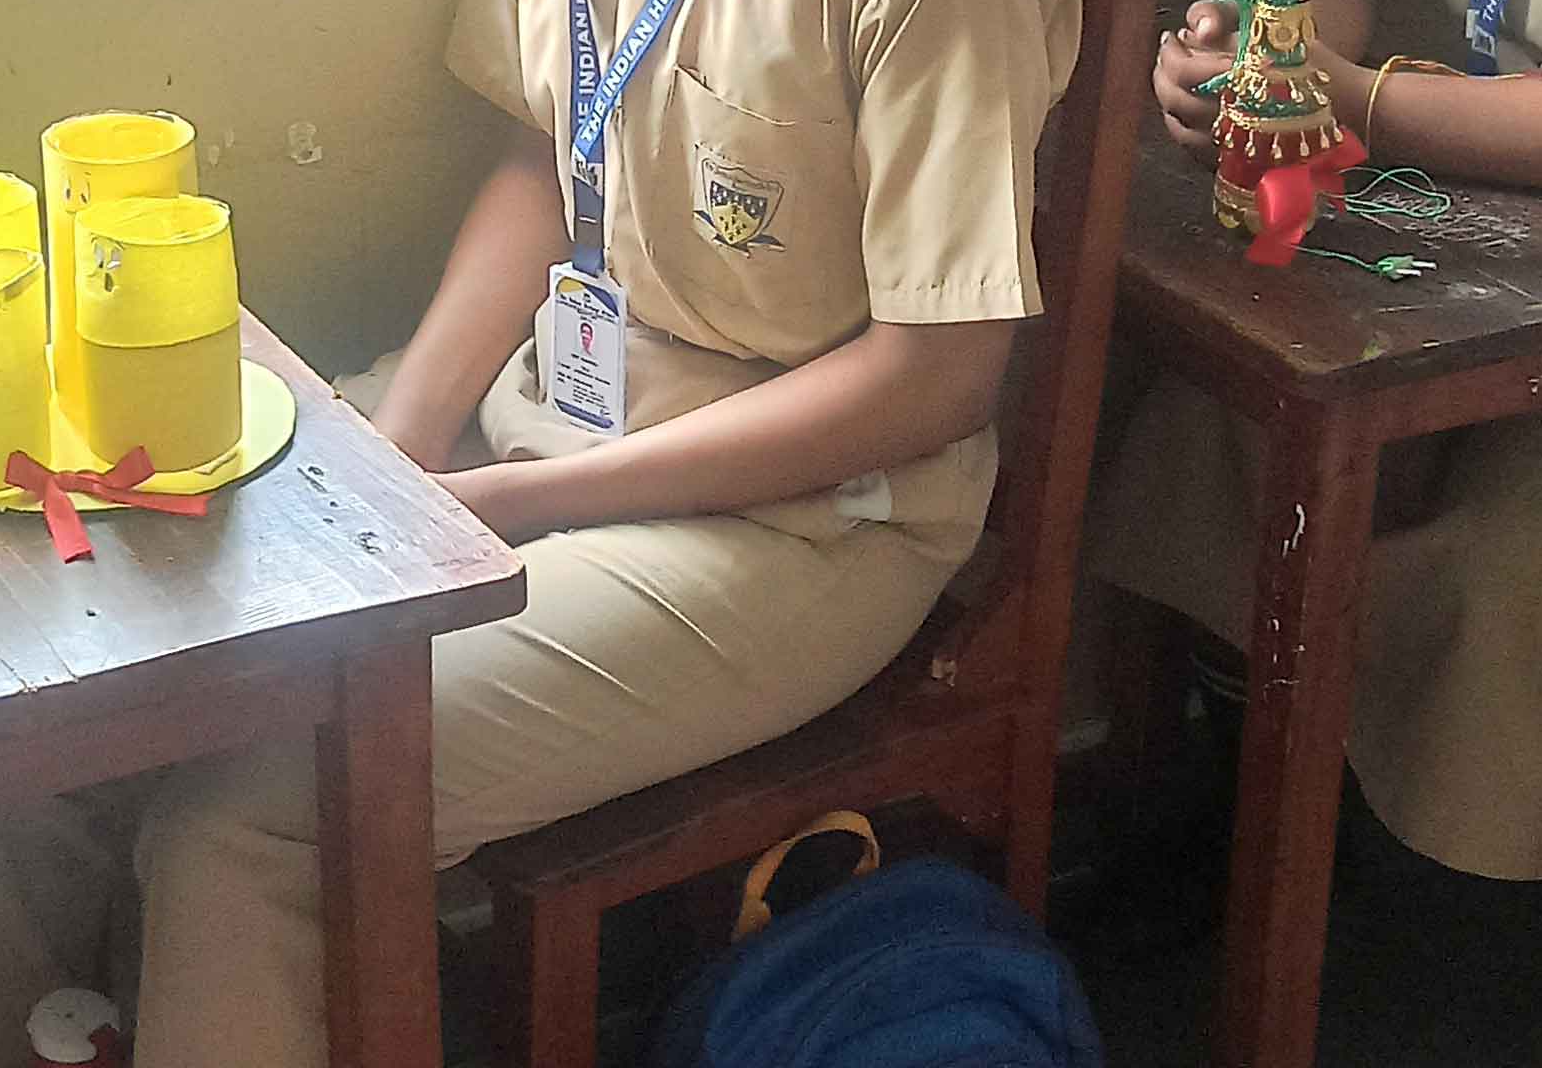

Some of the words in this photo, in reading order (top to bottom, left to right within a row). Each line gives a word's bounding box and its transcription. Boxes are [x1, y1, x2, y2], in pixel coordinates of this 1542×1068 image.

[575, 13, 596, 95] INDIAN
[579, 97, 608, 143] THE
[602, 18, 656, 98] INDIAN
